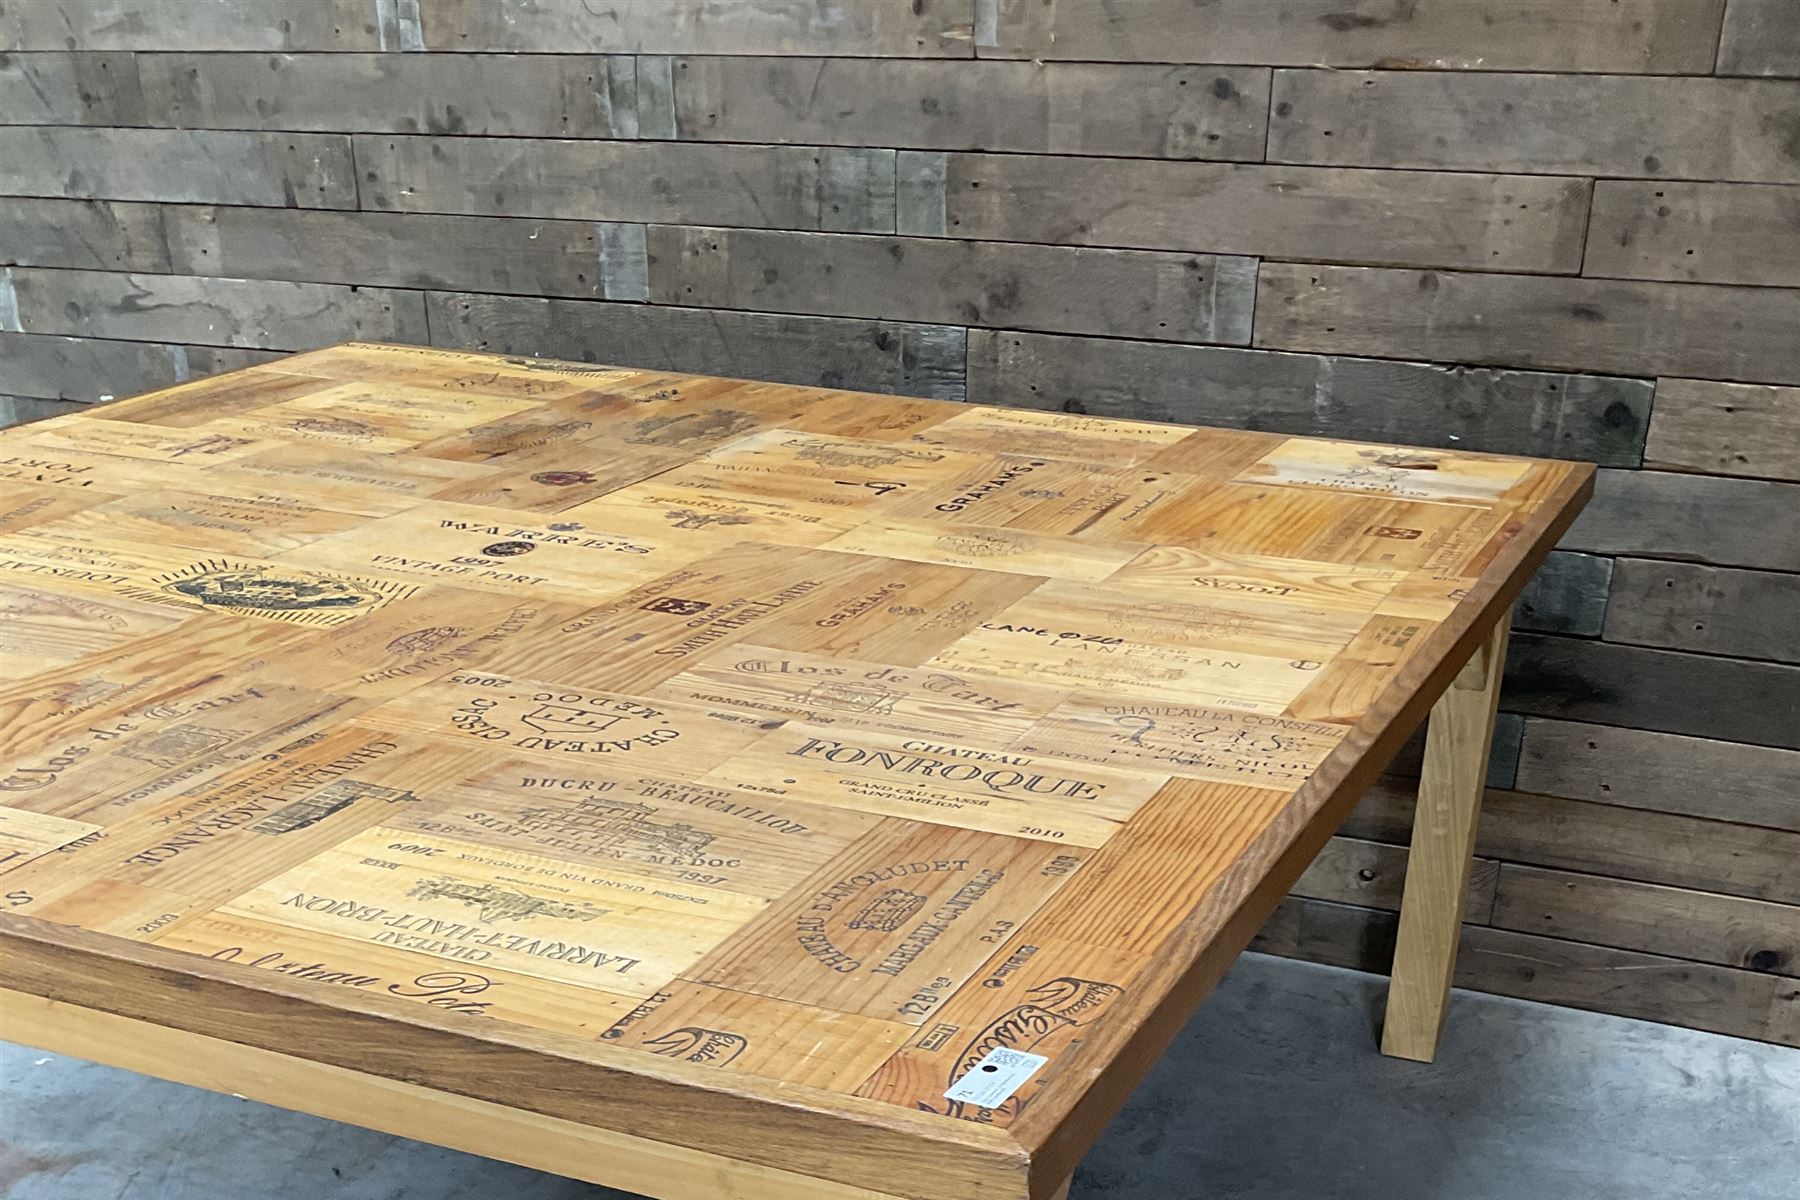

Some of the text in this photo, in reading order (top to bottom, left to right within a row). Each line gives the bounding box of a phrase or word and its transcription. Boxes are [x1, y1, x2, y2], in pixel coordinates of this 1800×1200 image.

[439, 519, 656, 555] WARRE'S
[371, 555, 476, 574] VINTAGE
[479, 570, 548, 585] PORT
[449, 555, 505, 568] 1997
[655, 629, 728, 658] SMITH
[1048, 639, 1243, 669] LANESSAN
[449, 675, 512, 688] 2005
[1104, 705, 1208, 718] CHATEAU
[514, 728, 680, 753] CHATEAU
[901, 740, 1034, 767] CHATEAU
[281, 742, 397, 794] CHATEAU
[786, 736, 1107, 801] FONROQUE
[638, 778, 732, 797] CHATEAU
[839, 778, 897, 793] GRAND
[897, 785, 927, 798] CRU
[1018, 825, 1065, 839] 2010
[537, 867, 557, 876] DE
[559, 872, 587, 883] VIN
[590, 878, 646, 893] GRAND
[372, 930, 493, 962] CHATEAU
